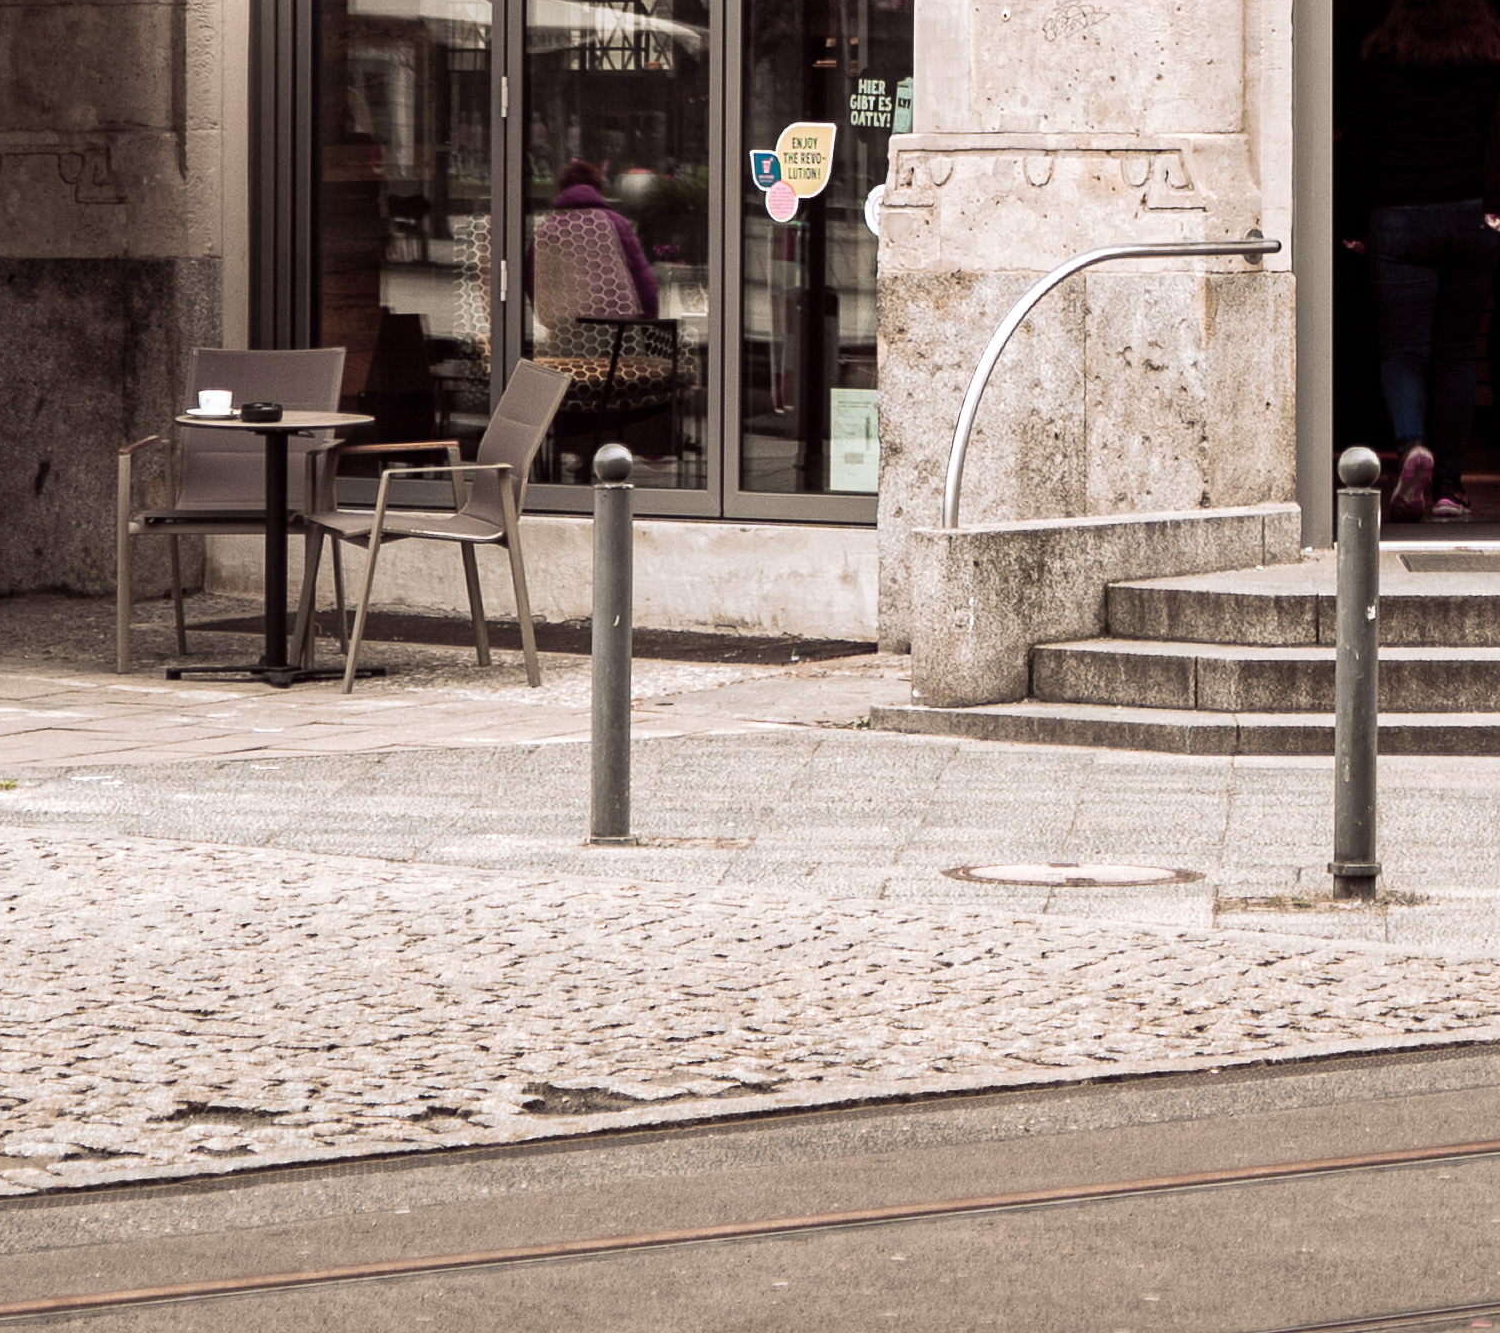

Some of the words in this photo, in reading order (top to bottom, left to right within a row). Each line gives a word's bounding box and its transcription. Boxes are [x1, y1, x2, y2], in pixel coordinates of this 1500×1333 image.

[858, 79, 885, 95] HIER
[850, 94, 874, 110] GIBT
[878, 96, 892, 111] ES
[851, 111, 891, 128] OATLY!
[792, 137, 818, 149] ENJOY
[783, 152, 798, 164] THE
[800, 152, 827, 165] REVO-
[788, 167, 821, 180] LUTION!
